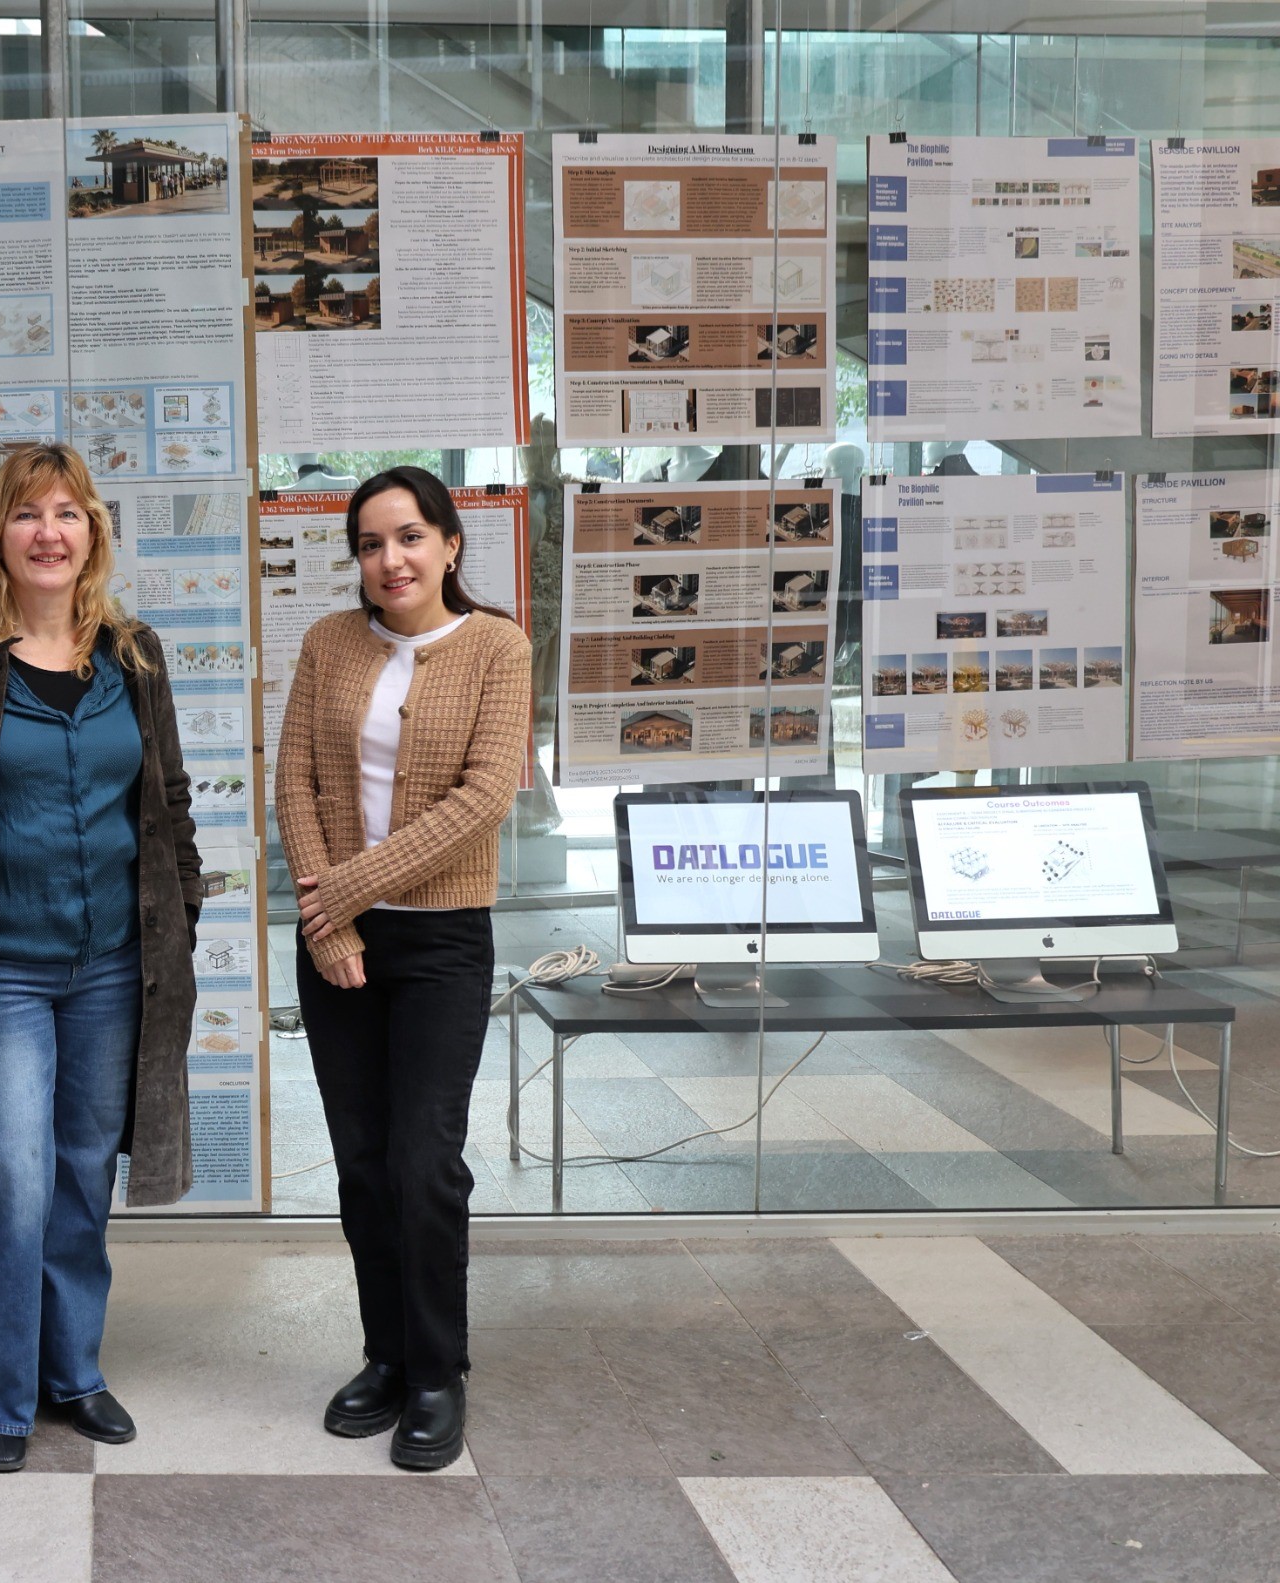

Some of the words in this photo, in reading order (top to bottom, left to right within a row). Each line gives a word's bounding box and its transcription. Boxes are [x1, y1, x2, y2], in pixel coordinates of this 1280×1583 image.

[271, 134, 348, 144] ORGANIZATION
[350, 134, 362, 144] OF
[366, 134, 386, 143] THE
[388, 134, 469, 143] ARCHITECTURAL
[471, 134, 519, 143] COLEX
[287, 147, 311, 155] Project
[648, 145, 689, 154] Designing
[689, 145, 696, 153] A
[698, 145, 720, 153] Micro
[722, 145, 754, 154] Museum
[907, 144, 919, 153] The
[920, 144, 950, 154] Biophilic
[1158, 146, 1195, 155] SEASIDE
[1196, 146, 1240, 154] PAVILLION
[907, 157, 933, 167] Pavilion
[1142, 480, 1178, 489] SEASIDE
[1181, 478, 1225, 487] PAVILLION
[476, 488, 524, 497] COLEX
[898, 484, 909, 493] The
[911, 484, 939, 494] Biophilic
[297, 505, 319, 514] Project
[502, 498, 521, 506] İNAN
[898, 497, 924, 507] Pavilion
[987, 800, 1020, 809] Course
[1023, 799, 1070, 808] Outcomes
[652, 844, 828, 870] DAILOGUE
[657, 875, 674, 883] We
[712, 874, 745, 885] longer
[749, 874, 798, 884] deigning
[801, 874, 832, 882] alone.
[931, 911, 981, 919] DAILOGUE
